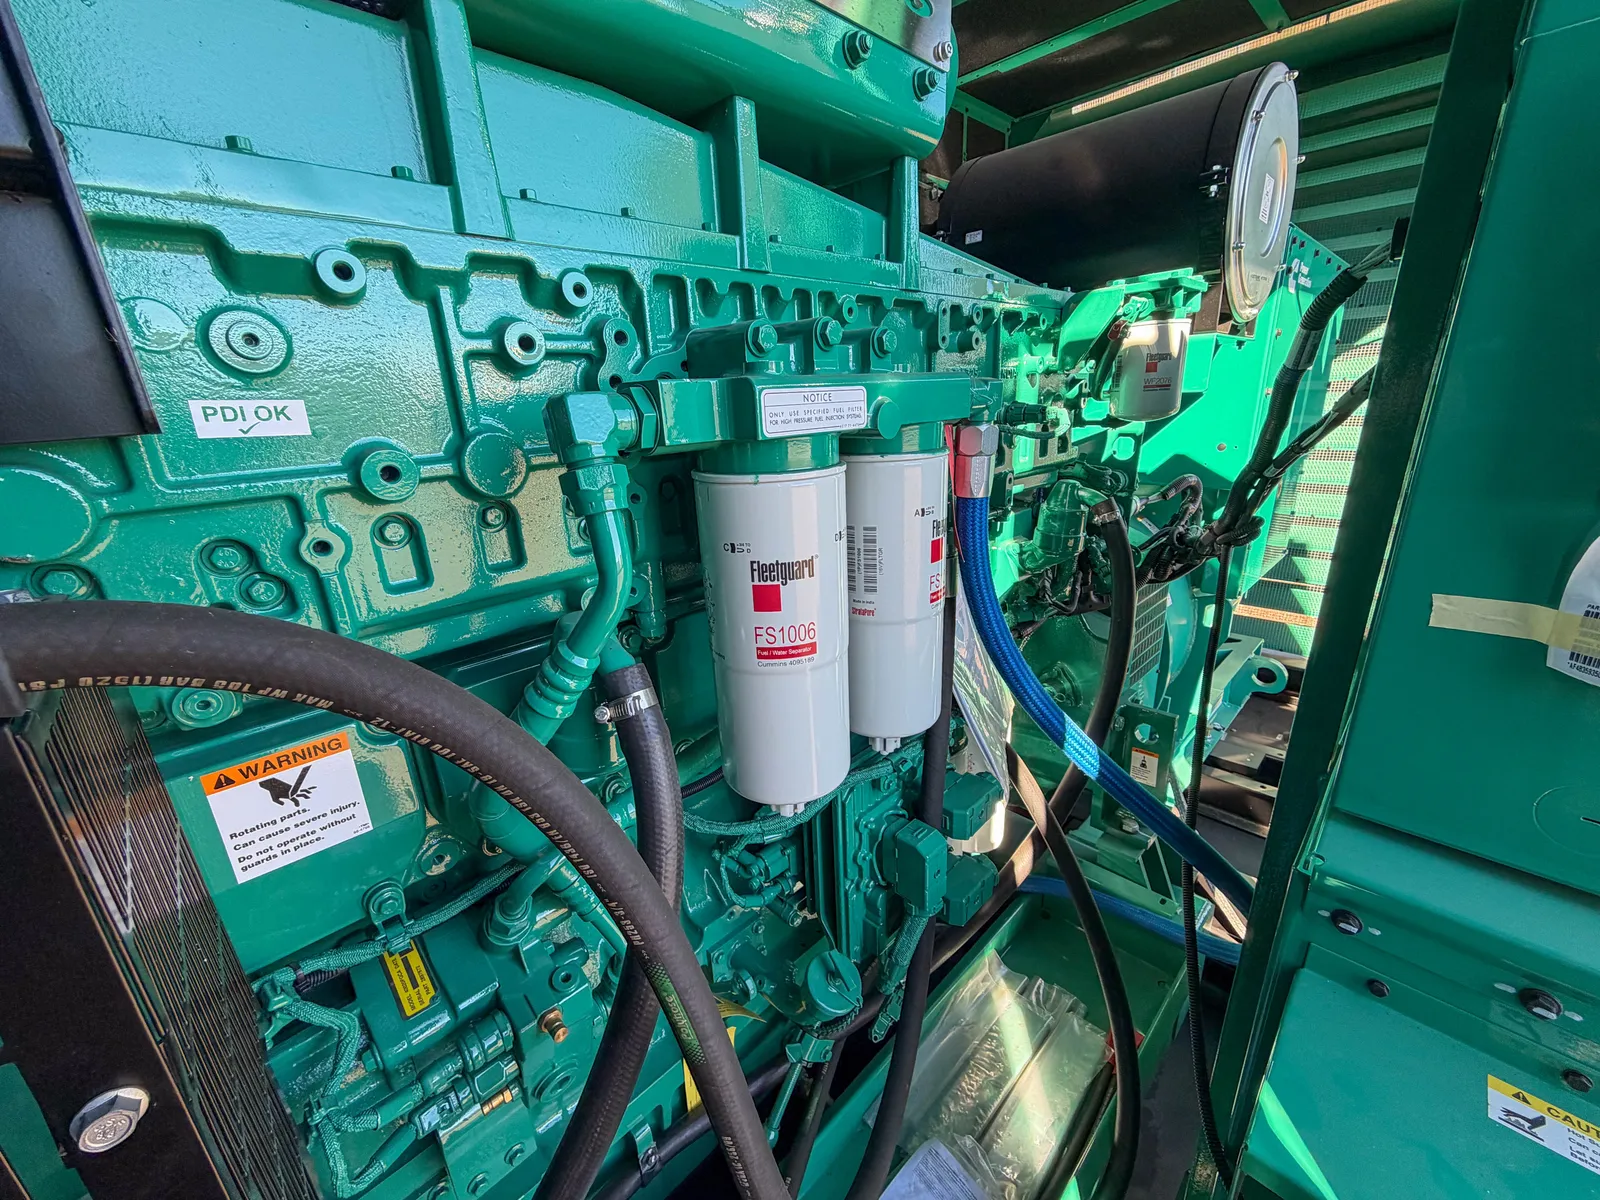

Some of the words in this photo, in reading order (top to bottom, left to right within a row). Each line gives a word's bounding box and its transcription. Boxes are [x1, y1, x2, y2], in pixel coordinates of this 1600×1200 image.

[1143, 377, 1172, 385] WF2076
[803, 393, 832, 402] NOTICE
[201, 405, 247, 422] PDI
[254, 405, 293, 421] OK
[803, 407, 830, 416] SPECIFIED
[794, 416, 813, 424] PRESSURE
[1587, 603, 1600, 611] PAR
[754, 622, 816, 644] FS1006
[789, 646, 812, 655] Separator
[18, 678, 65, 692] PSI
[159, 676, 205, 687] BAR
[213, 680, 251, 693] 105
[257, 687, 288, 699] WP
[292, 693, 334, 709] MAX
[237, 737, 343, 780] WARNING
[430, 744, 456, 759] 100
[229, 819, 278, 840] Rotating
[279, 807, 311, 823] parts.
[233, 839, 256, 851] Can
[259, 826, 291, 842] cause
[293, 812, 328, 829] severe
[330, 801, 360, 815] injury.
[238, 854, 253, 864] Do
[256, 845, 274, 857] not
[276, 830, 317, 851] operate
[319, 813, 356, 832] without
[241, 853, 278, 872] guards
[281, 848, 291, 856] in
[293, 837, 325, 852] place.
[578, 864, 598, 878] ISO
[1567, 1128, 1586, 1140] Hot
[1568, 1137, 1590, 1151] Can
[1569, 1145, 1587, 1158] Let
